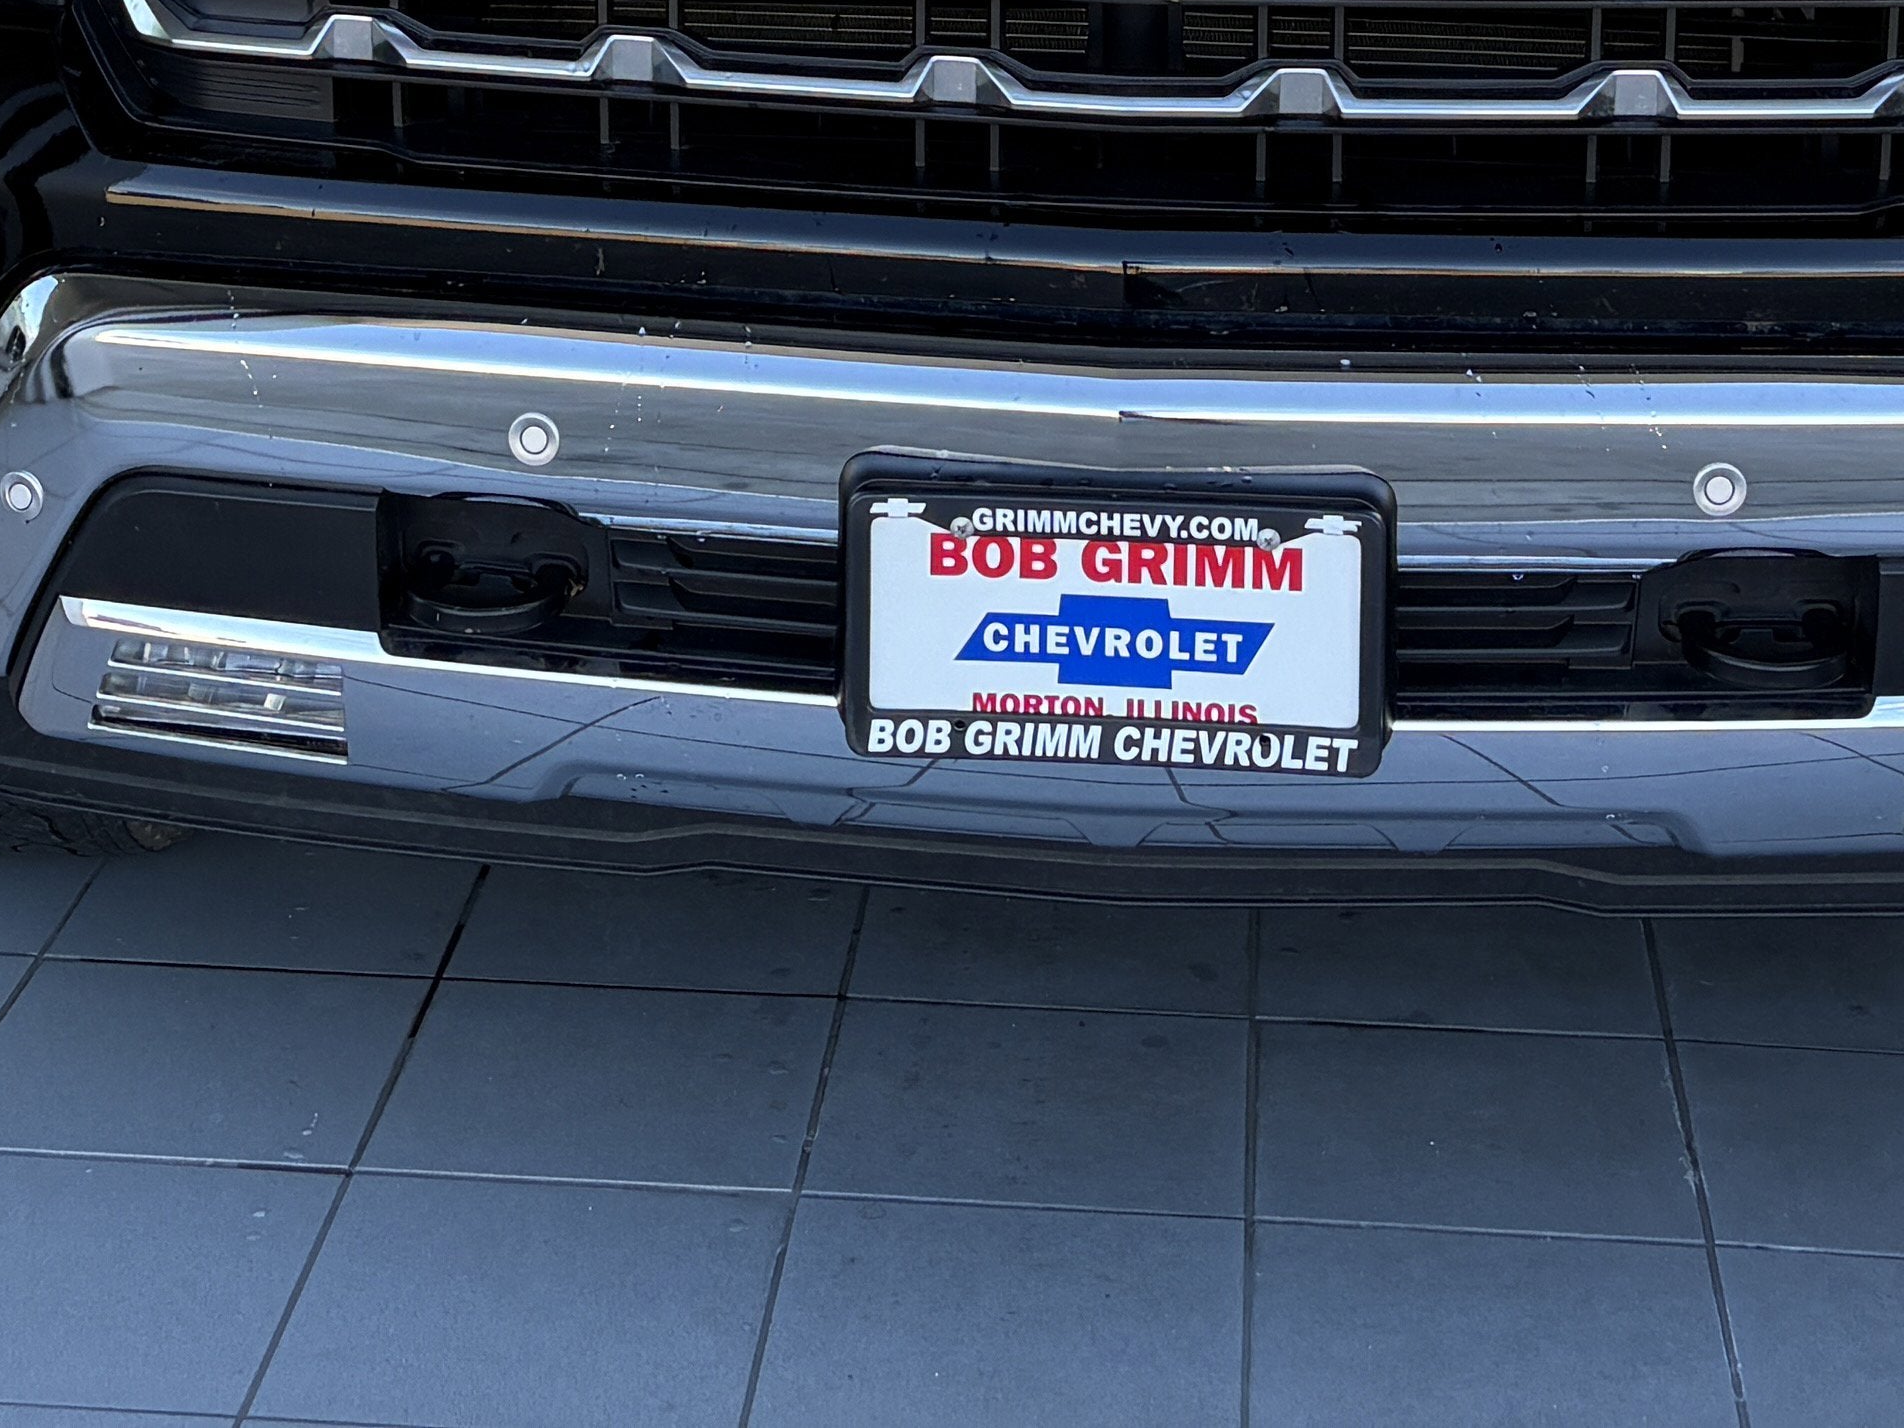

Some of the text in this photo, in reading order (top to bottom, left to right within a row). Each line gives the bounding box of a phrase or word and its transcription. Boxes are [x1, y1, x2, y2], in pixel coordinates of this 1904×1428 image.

[971, 507, 1259, 543] GRIMMCHEVY.COM
[930, 532, 1303, 592] BOB GRIMM
[982, 621, 1243, 663] CHEVROLET
[972, 692, 1259, 725] MORTON ILLINOIS
[867, 718, 1359, 773] BOB GRIMM CHEVROLET
